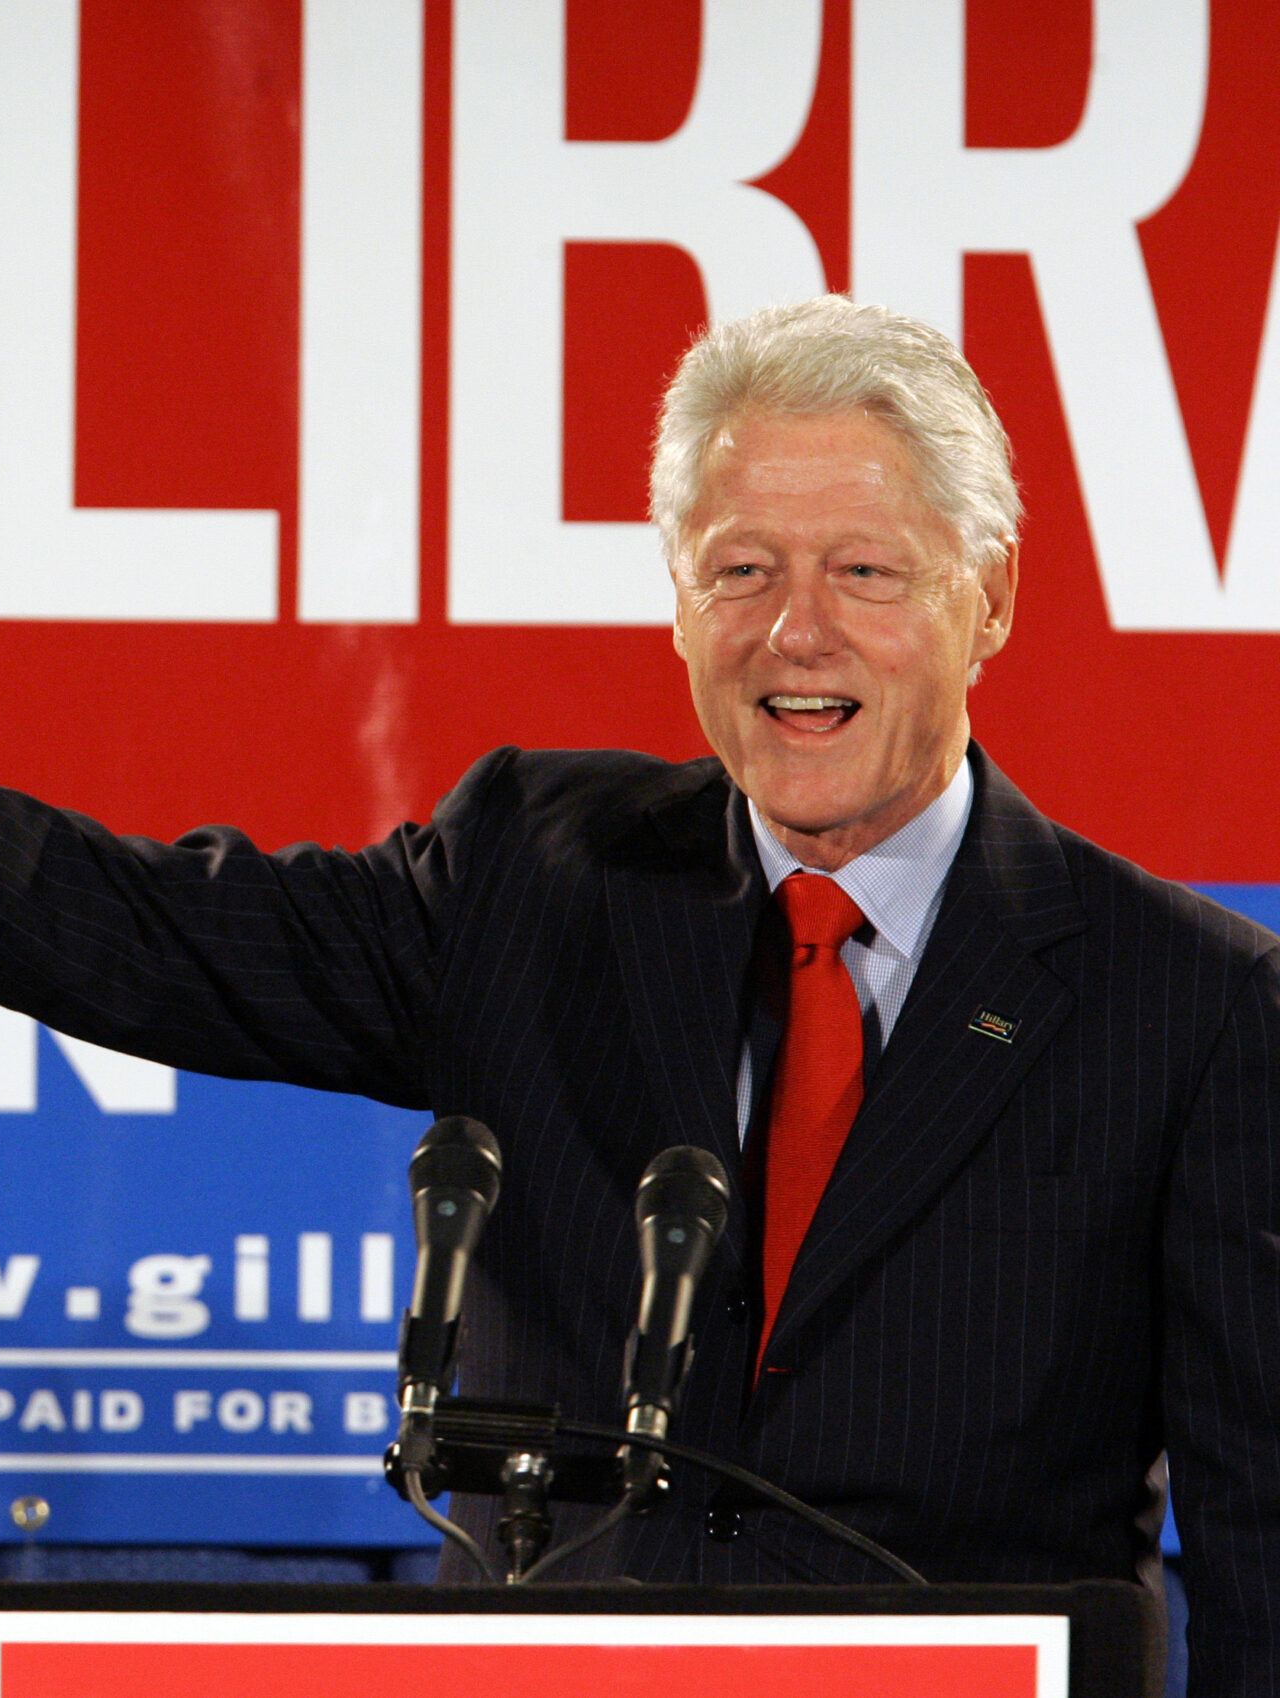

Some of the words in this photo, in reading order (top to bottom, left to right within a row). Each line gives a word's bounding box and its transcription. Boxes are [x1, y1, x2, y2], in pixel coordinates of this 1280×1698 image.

[980, 1010, 1014, 1032] Hillary
[174, 1390, 313, 1432] FOR
[343, 1391, 388, 1434] B
